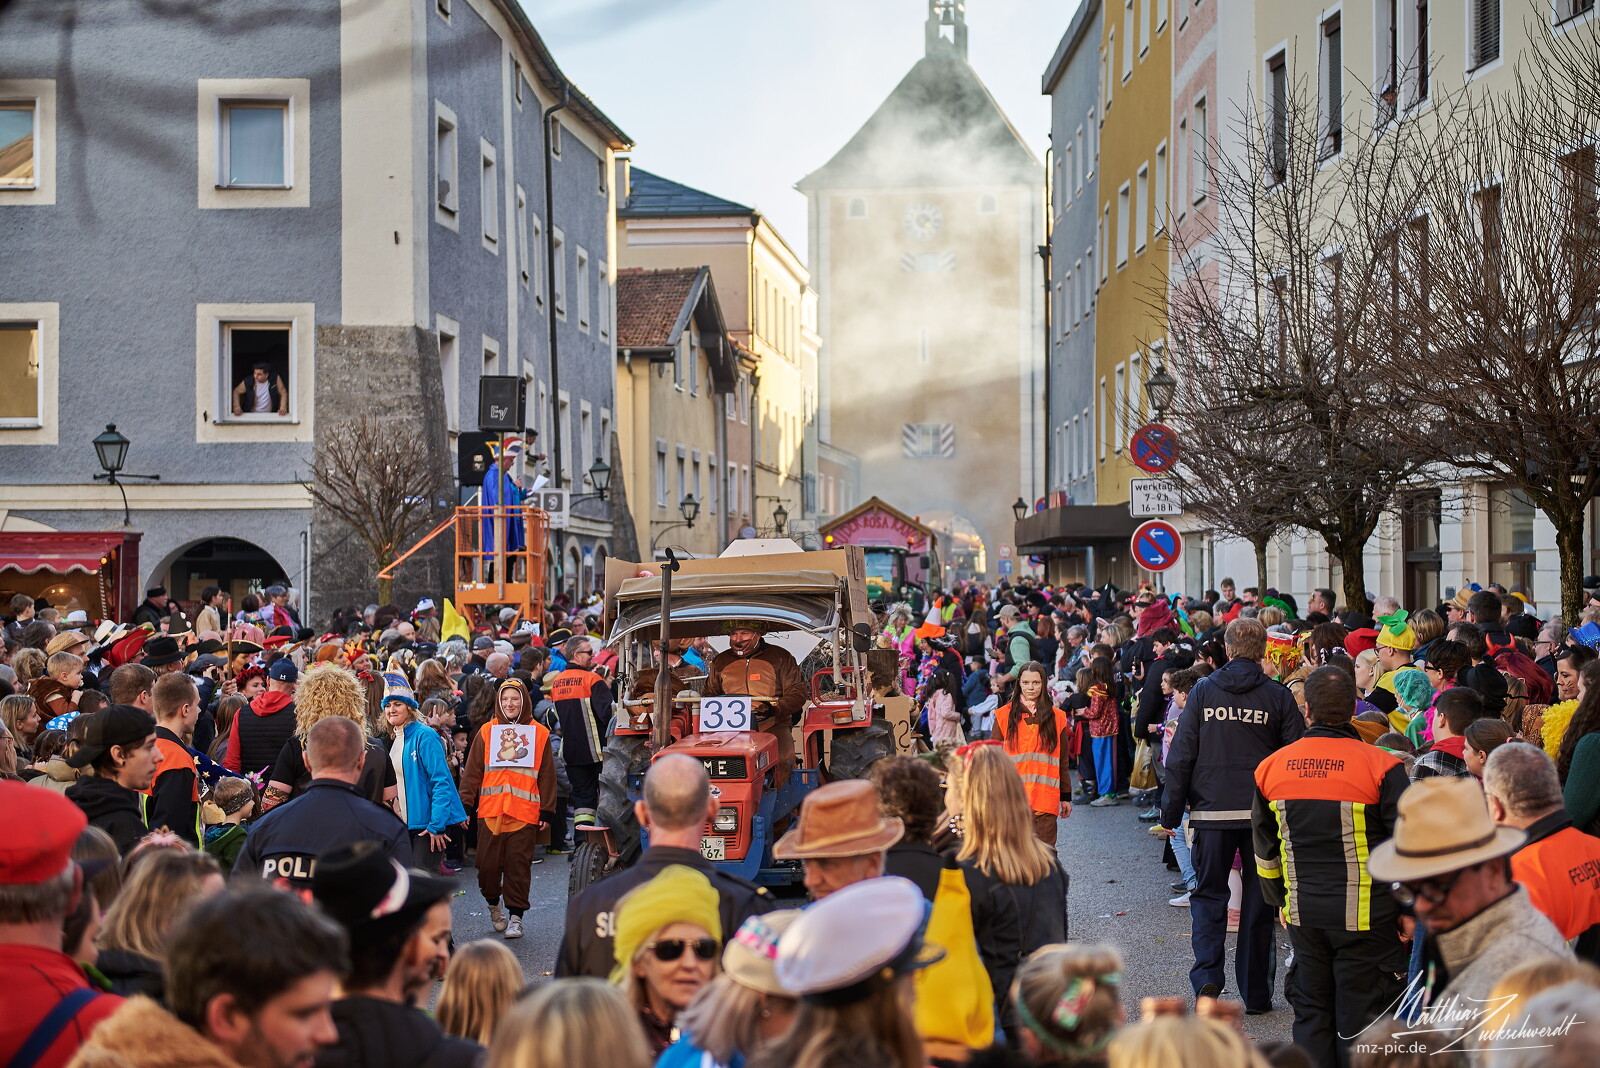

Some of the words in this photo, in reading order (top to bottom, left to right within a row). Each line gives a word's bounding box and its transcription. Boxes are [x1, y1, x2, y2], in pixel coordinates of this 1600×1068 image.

[1168, 503, 1173, 512] h
[863, 516, 889, 529] ROSA
[703, 699, 747, 729] 33
[1203, 706, 1269, 725] POLIZEI
[1286, 758, 1345, 772] FEUERWEHR
[1299, 770, 1328, 779] LAUFEN
[261, 856, 318, 879] POLI
